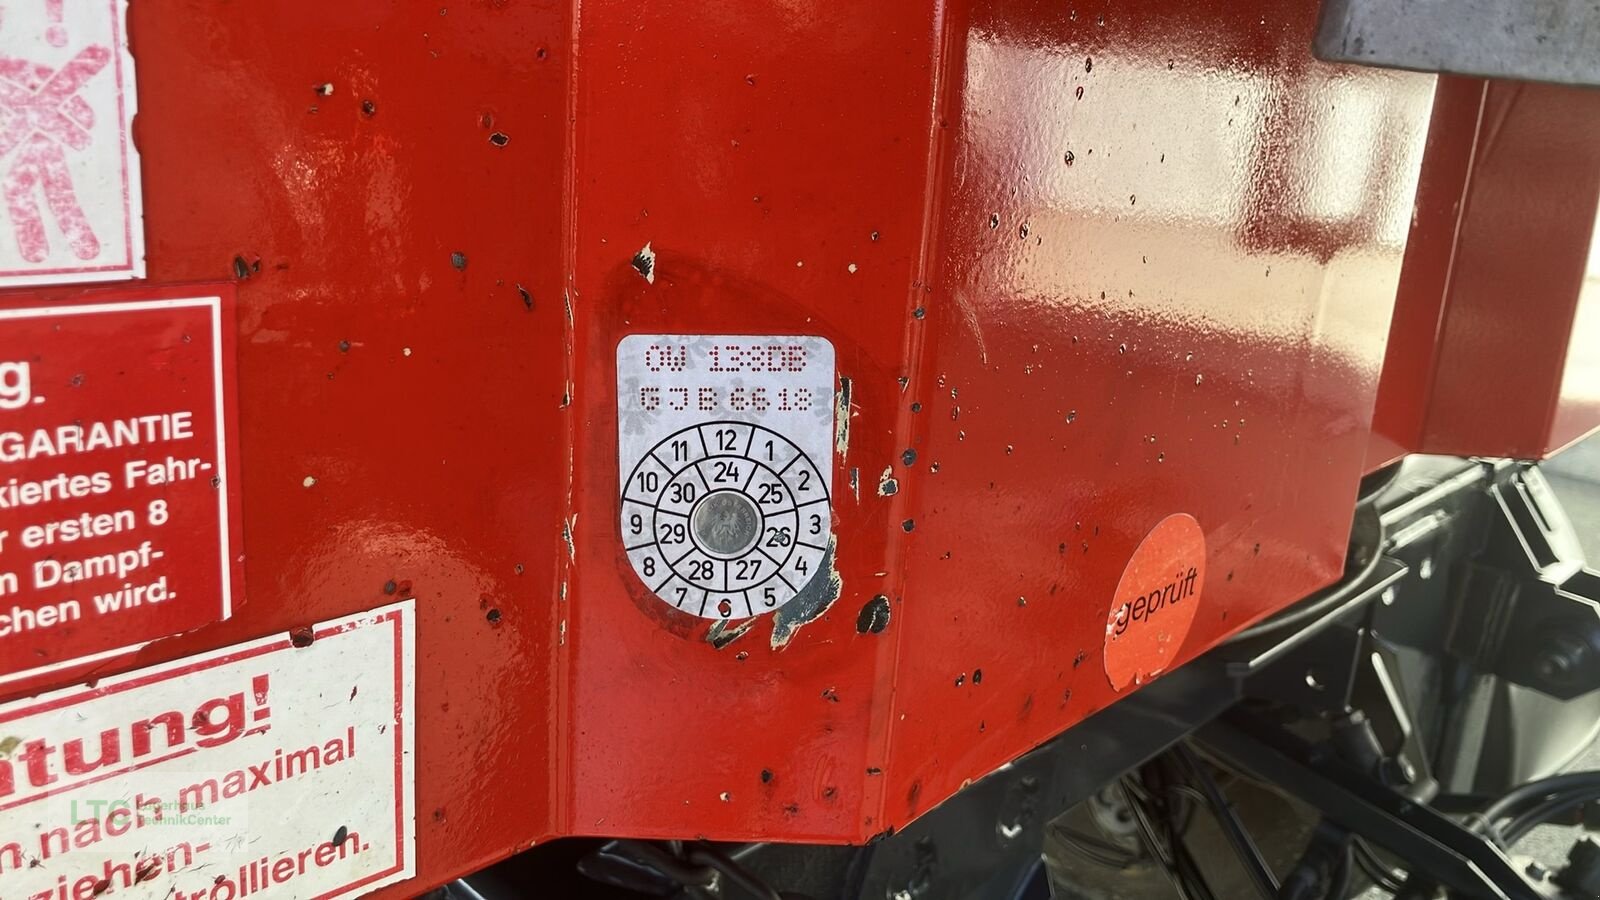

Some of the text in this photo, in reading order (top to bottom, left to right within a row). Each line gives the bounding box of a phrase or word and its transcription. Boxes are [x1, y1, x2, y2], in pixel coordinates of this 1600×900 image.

[0, 412, 193, 462] GARANTIE
[715, 430, 737, 451] 12
[671, 441, 688, 461] 11
[766, 441, 774, 460] 1
[126, 457, 211, 489] Fahr-
[637, 472, 658, 493] 10
[714, 462, 739, 483] 24
[798, 471, 810, 491] 2
[670, 483, 696, 504] 30
[758, 483, 783, 504] 25
[22, 509, 135, 548] ersten
[148, 499, 169, 525] 8
[630, 514, 643, 535] 9
[659, 524, 686, 544] 29
[809, 514, 822, 535] 3
[766, 527, 791, 548] 26
[34, 541, 164, 589] Dampf-
[643, 558, 655, 577] 8
[688, 560, 714, 580] 28
[735, 560, 762, 580] 27
[794, 556, 808, 576] 4
[94, 576, 176, 614] wird.
[675, 588, 688, 608] 7
[764, 587, 776, 607] 5
[1115, 567, 1197, 635] geprüft
[40, 792, 162, 860] nach
[179, 726, 355, 813] maximal
